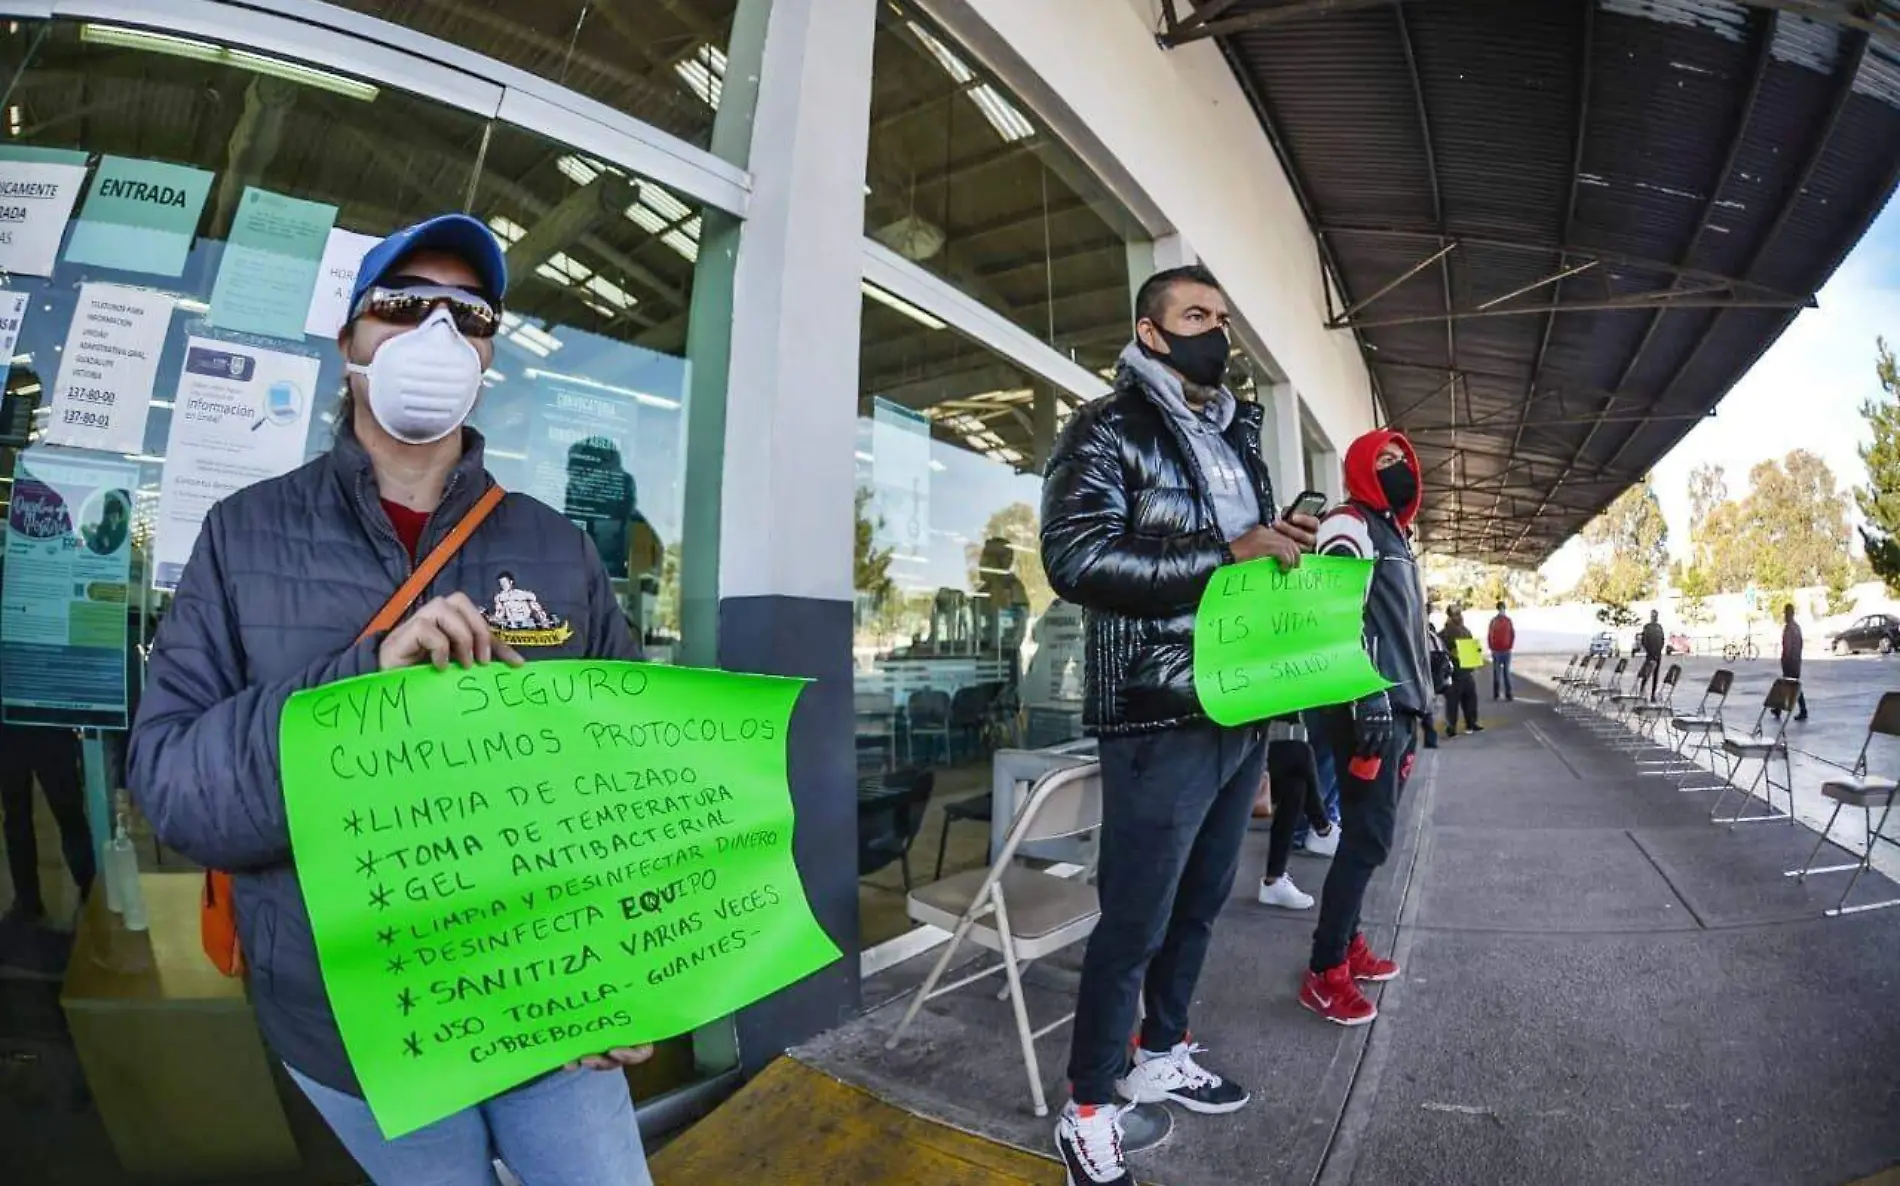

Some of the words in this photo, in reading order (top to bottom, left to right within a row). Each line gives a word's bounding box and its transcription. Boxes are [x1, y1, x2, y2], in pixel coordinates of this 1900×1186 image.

[100, 178, 187, 208] ENTRADA
[312, 677, 412, 735] GYM
[457, 668, 648, 716] SEGURO
[331, 729, 561, 779] CUMPLIMOS
[583, 718, 775, 750] PROTOCOLOS
[498, 821, 542, 848] DE
[557, 784, 734, 834] TEMPERATURA
[505, 781, 556, 807] DE
[574, 767, 698, 796] CALZADO
[405, 872, 476, 902] GEL
[511, 809, 735, 877] ANTIBACTERIAL
[410, 899, 507, 940] LIMPIA
[546, 845, 705, 902] DESINFECTAR
[715, 830, 779, 854] DINERO
[414, 905, 605, 966] DESINFECTA
[618, 868, 717, 920] EQUIPO
[430, 945, 602, 1006] SANITIZA
[619, 912, 703, 957] VARIAS
[713, 884, 780, 921] VECES
[433, 1016, 485, 1044] USO
[469, 1010, 633, 1064] CUBREBOCAS
